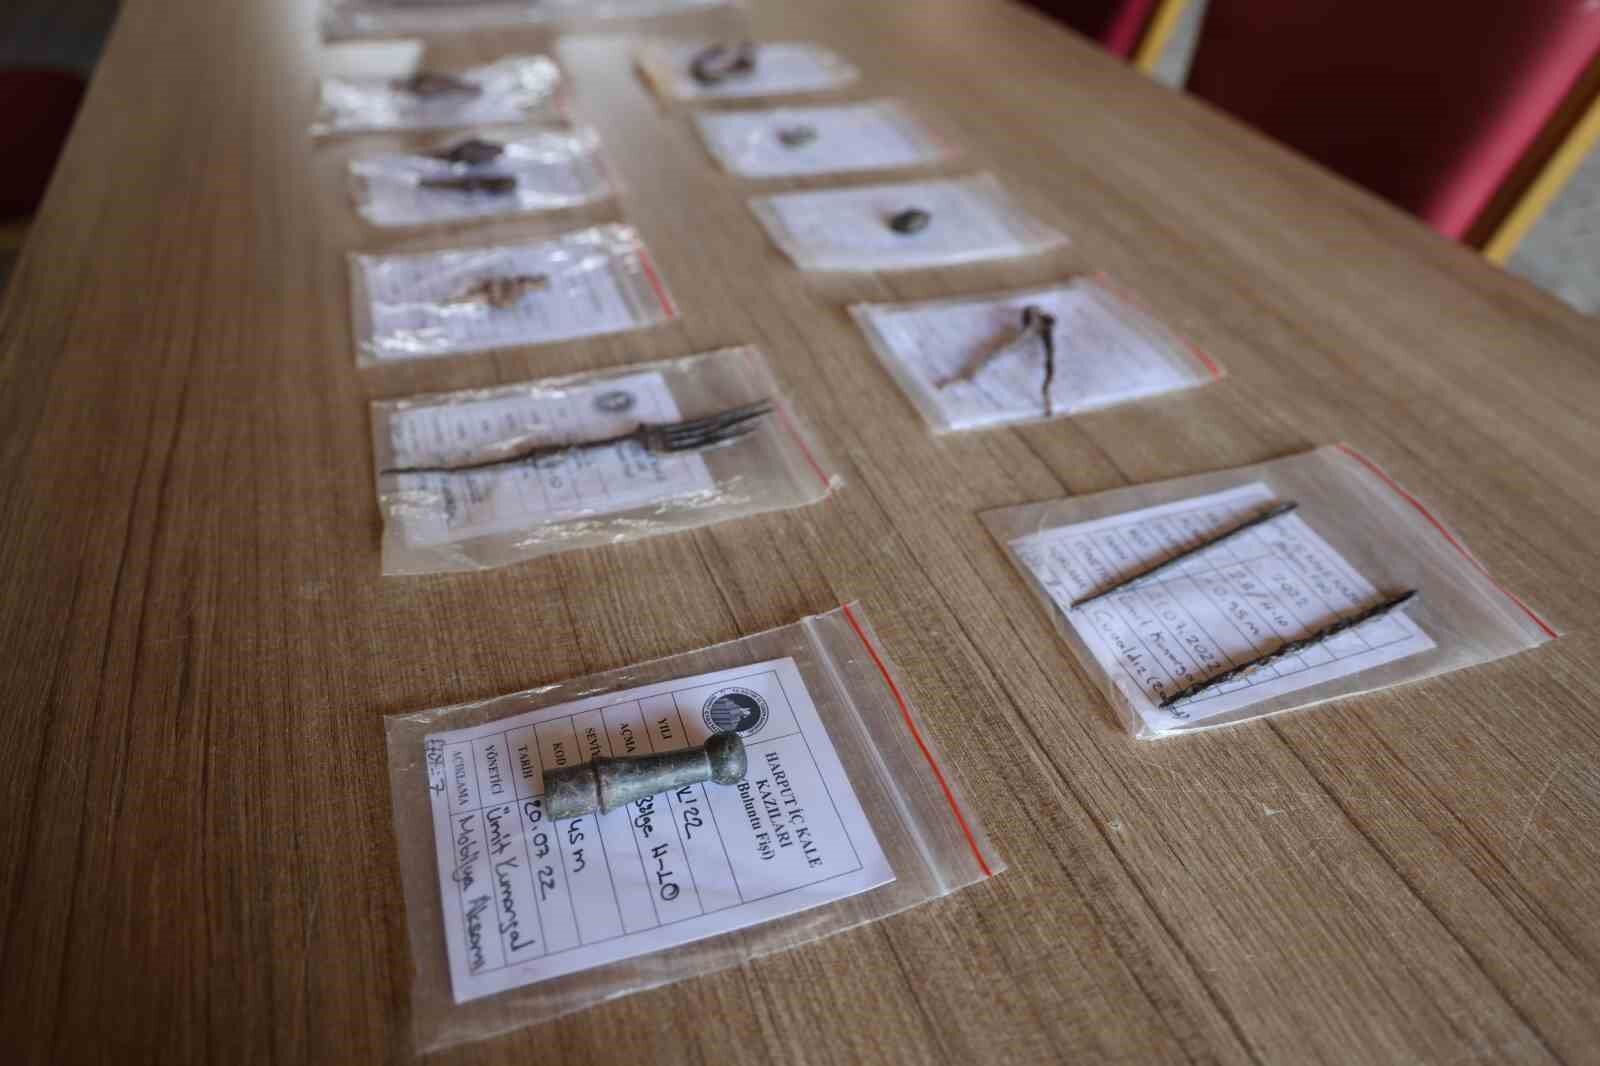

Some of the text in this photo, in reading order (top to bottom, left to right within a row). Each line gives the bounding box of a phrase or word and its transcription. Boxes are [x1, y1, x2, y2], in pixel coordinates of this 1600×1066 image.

[552, 742, 566, 766] KOD
[584, 727, 602, 757] SEVİY
[620, 722, 637, 753] AÇMA
[657, 717, 672, 740] YILI
[451, 751, 469, 806] AÇIKLAMA
[484, 744, 505, 796] YÖNETİCİ
[517, 744, 534, 778] TARİH
[736, 779, 762, 831] Buluntu
[755, 779, 793, 848] KAZILARI
[765, 751, 823, 868] HARPUT İÇ KALE
[452, 814, 480, 892] Mobilya
[486, 806, 513, 856] Ümit
